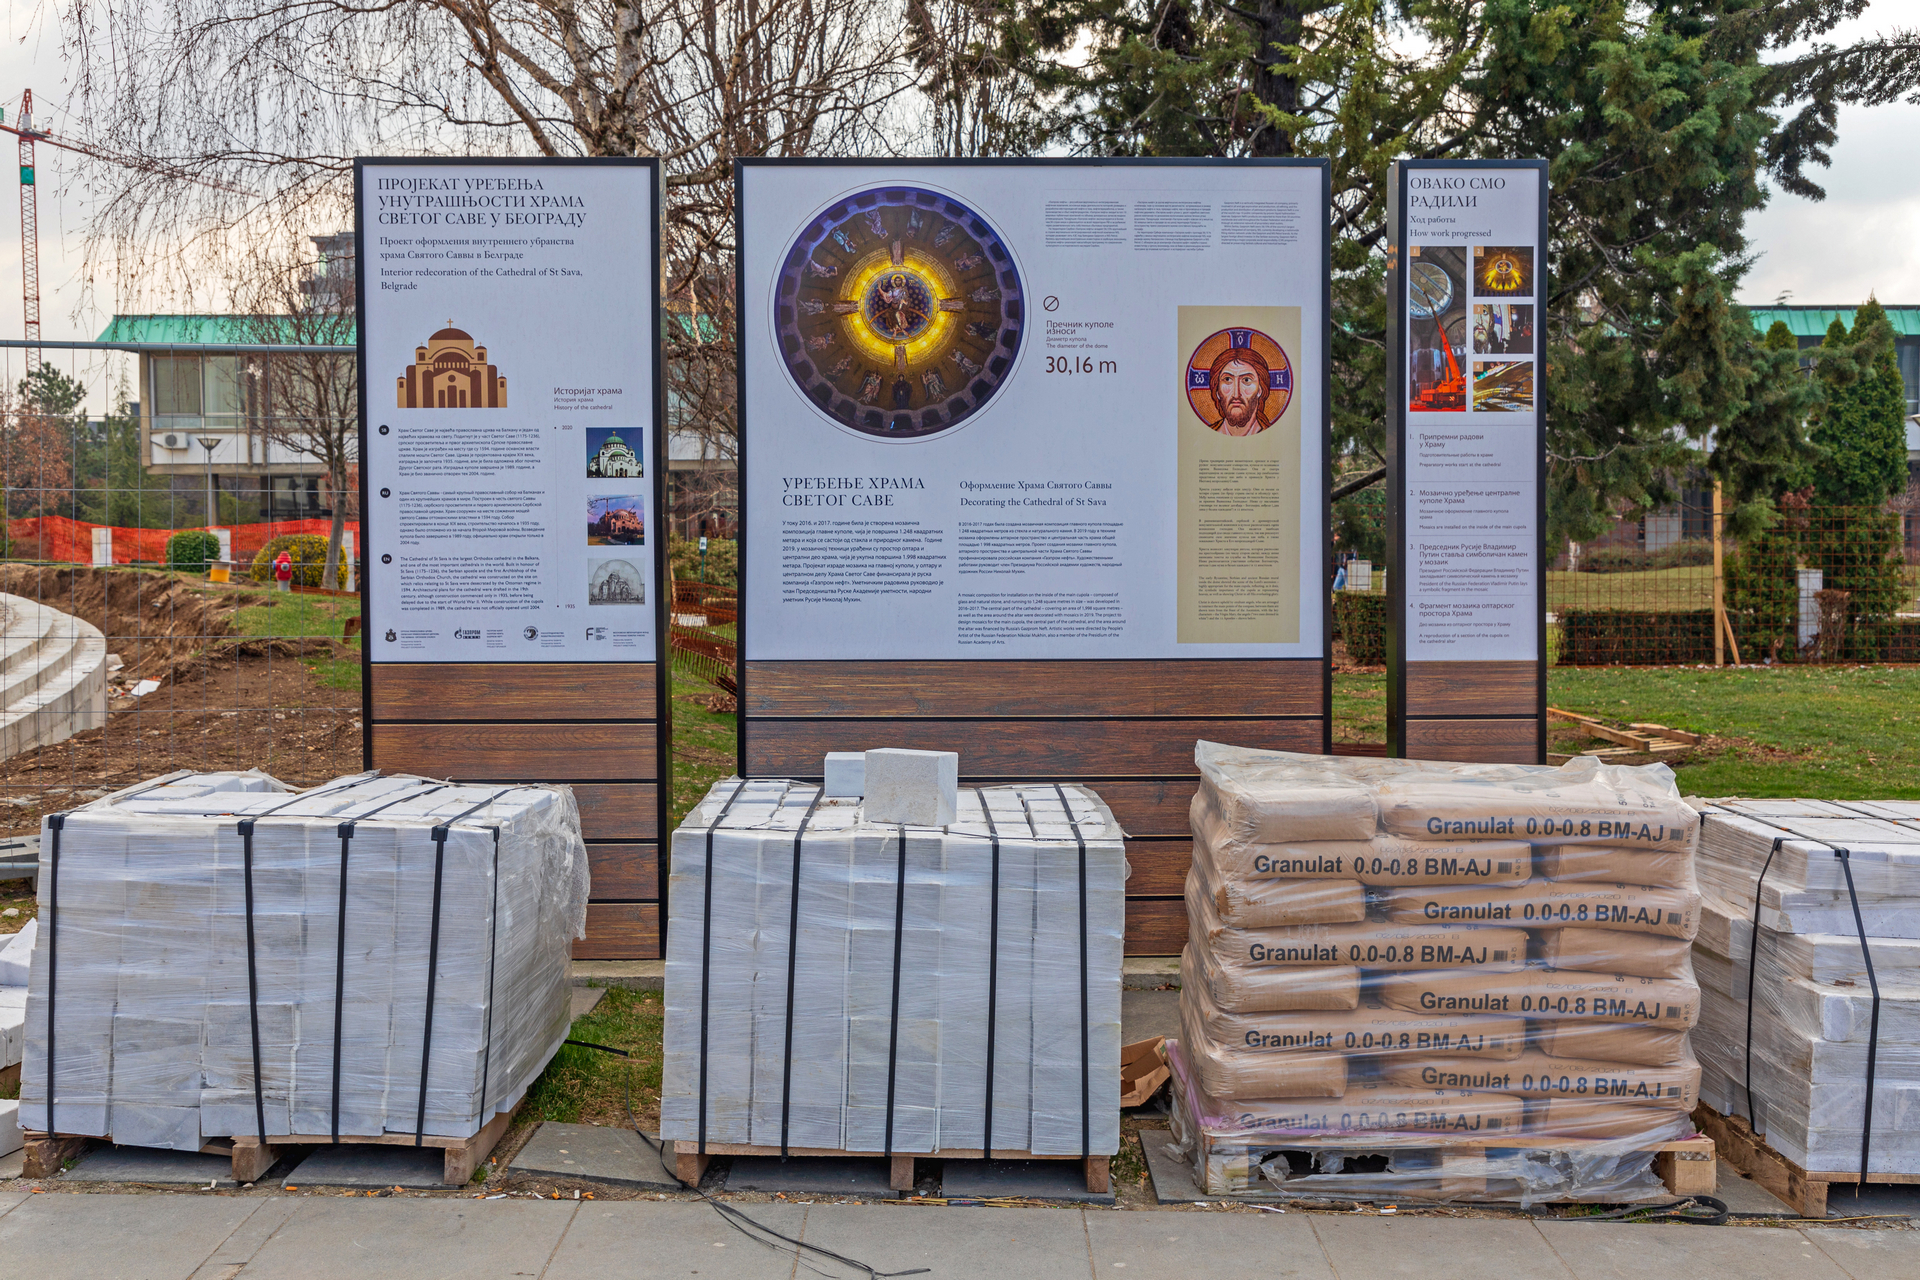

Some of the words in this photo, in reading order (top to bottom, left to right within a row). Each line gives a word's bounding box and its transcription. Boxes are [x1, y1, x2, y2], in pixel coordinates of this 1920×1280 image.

[379, 178, 460, 193] ПРОЈЕКАТ
[464, 179, 543, 193] УРЕЂЕЊА
[1410, 178, 1465, 189] ОВАКО
[1470, 178, 1505, 189] СМО
[379, 196, 525, 210] УНУТРАШЊОСТИ
[530, 196, 584, 207] ХРАМА
[1410, 196, 1477, 209] РАДИЛИ
[379, 213, 441, 224] СВЕТОГ
[446, 213, 486, 224] САВЕ
[490, 213, 500, 228] У
[506, 213, 586, 228] БЕОГРАДУ
[1428, 216, 1455, 225] работы
[1452, 229, 1491, 239] progressed
[380, 237, 413, 247] Проект
[416, 237, 469, 247] оформления
[530, 237, 574, 247] убранства
[484, 251, 523, 261] Белграде
[496, 268, 536, 276] Cathedral
[561, 268, 582, 276] Sava,
[381, 282, 417, 292] Belgrade
[1047, 320, 1082, 329] Пречник
[1046, 356, 1093, 375] 30,16
[1100, 361, 1116, 373] m
[554, 387, 595, 396] Историјат
[1425, 441, 1445, 449] Храму
[783, 478, 863, 492] УРЕЂЕЊЕ
[869, 478, 924, 488] ХРАМА
[960, 481, 1015, 491] Оформление
[1018, 481, 1044, 491] Храма
[783, 495, 846, 506] СВЕТОГ
[852, 495, 893, 506] САВЕ
[961, 498, 1005, 508] Decorating
[1420, 551, 1439, 559] Путин
[1427, 816, 1514, 834] Granulat
[1526, 818, 1591, 837] 0.0-0.8
[1598, 821, 1664, 842] BM-AJ
[1254, 855, 1342, 873] Granulat
[1354, 856, 1418, 876] 0.0-0.8
[1425, 858, 1492, 876] BM-AJ
[1424, 901, 1512, 919] Granulat
[1523, 903, 1588, 921] 0.0-0.8
[1595, 904, 1662, 926] BM-AJ
[1250, 943, 1338, 961] Granulat
[1350, 944, 1414, 963] 0.0-0.8
[1421, 945, 1488, 964] BM-AJ
[1420, 992, 1509, 1011] Granulat
[1521, 995, 1586, 1015] 0.0-0.8
[1593, 998, 1661, 1019] BM-AJ
[1245, 1030, 1332, 1048] Granulat
[1345, 1032, 1410, 1049] 0.0-0.8
[1417, 1032, 1484, 1052] BM-AJ
[1421, 1066, 1510, 1089] Granulat
[1522, 1074, 1588, 1094] 0.0-0.8
[1594, 1077, 1662, 1099] BM-AJ
[1240, 1113, 1328, 1130] Granulat
[1415, 1112, 1481, 1131] BM-AJ
